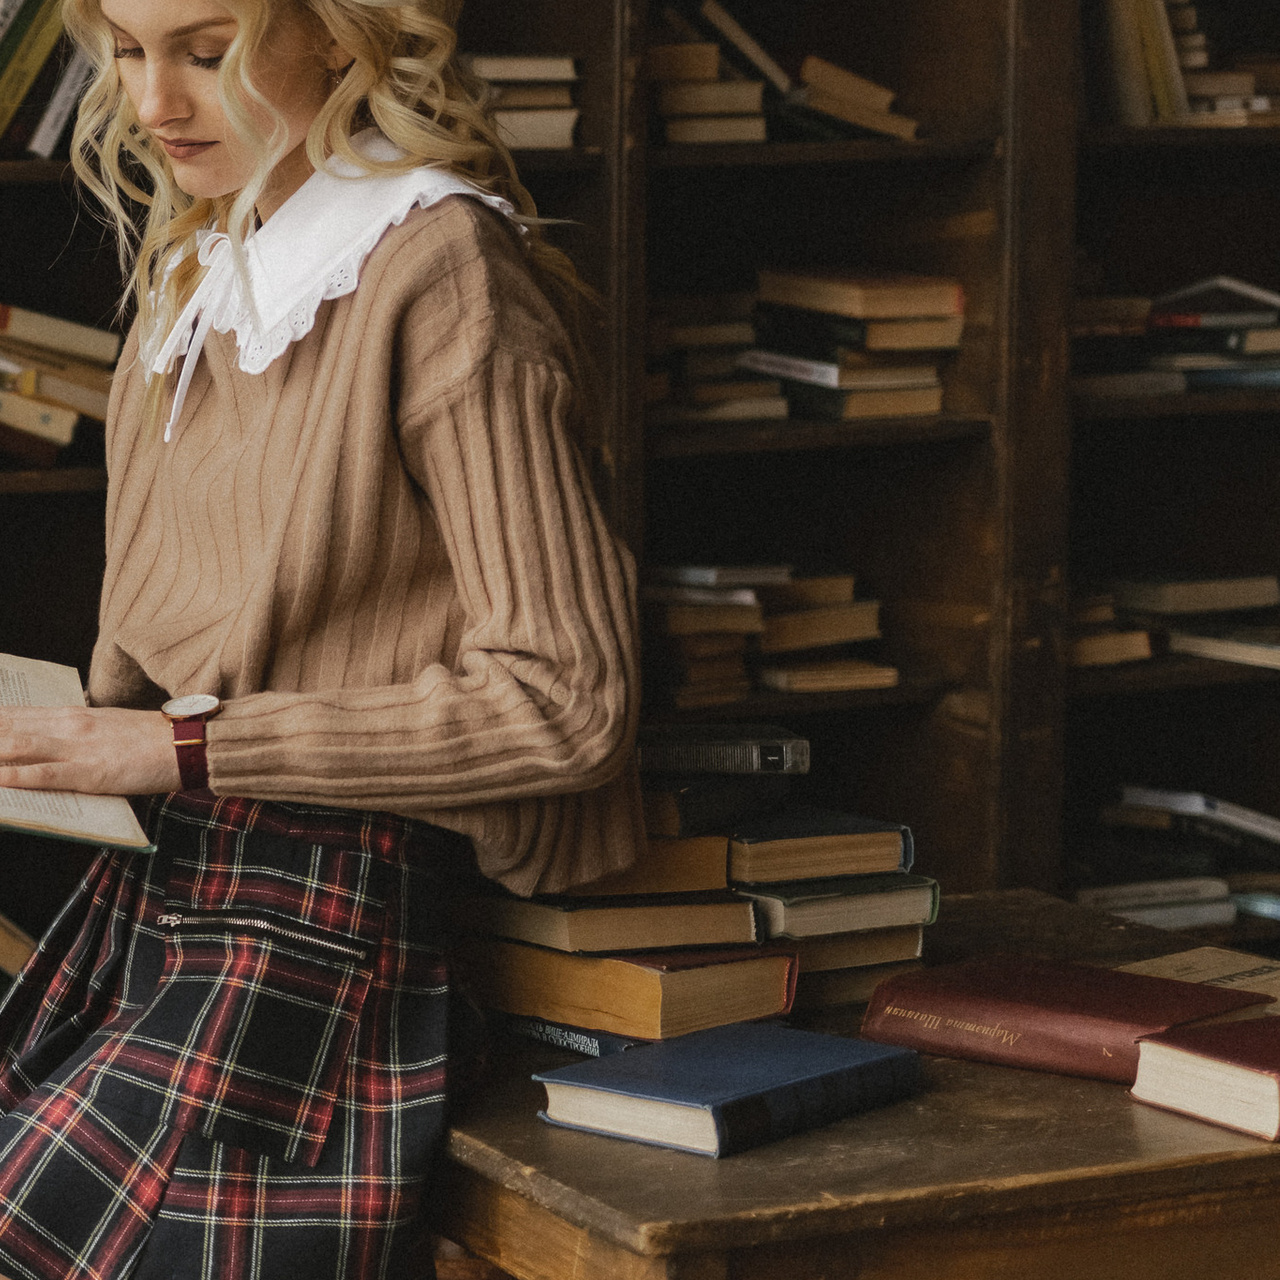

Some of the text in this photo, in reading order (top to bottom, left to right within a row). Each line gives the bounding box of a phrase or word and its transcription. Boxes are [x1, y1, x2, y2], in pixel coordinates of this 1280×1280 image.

[545, 1025, 599, 1048] ВИЦЕ-АДМИРАЛА
[884, 1005, 1022, 1046] Мариэтта Шагинян
